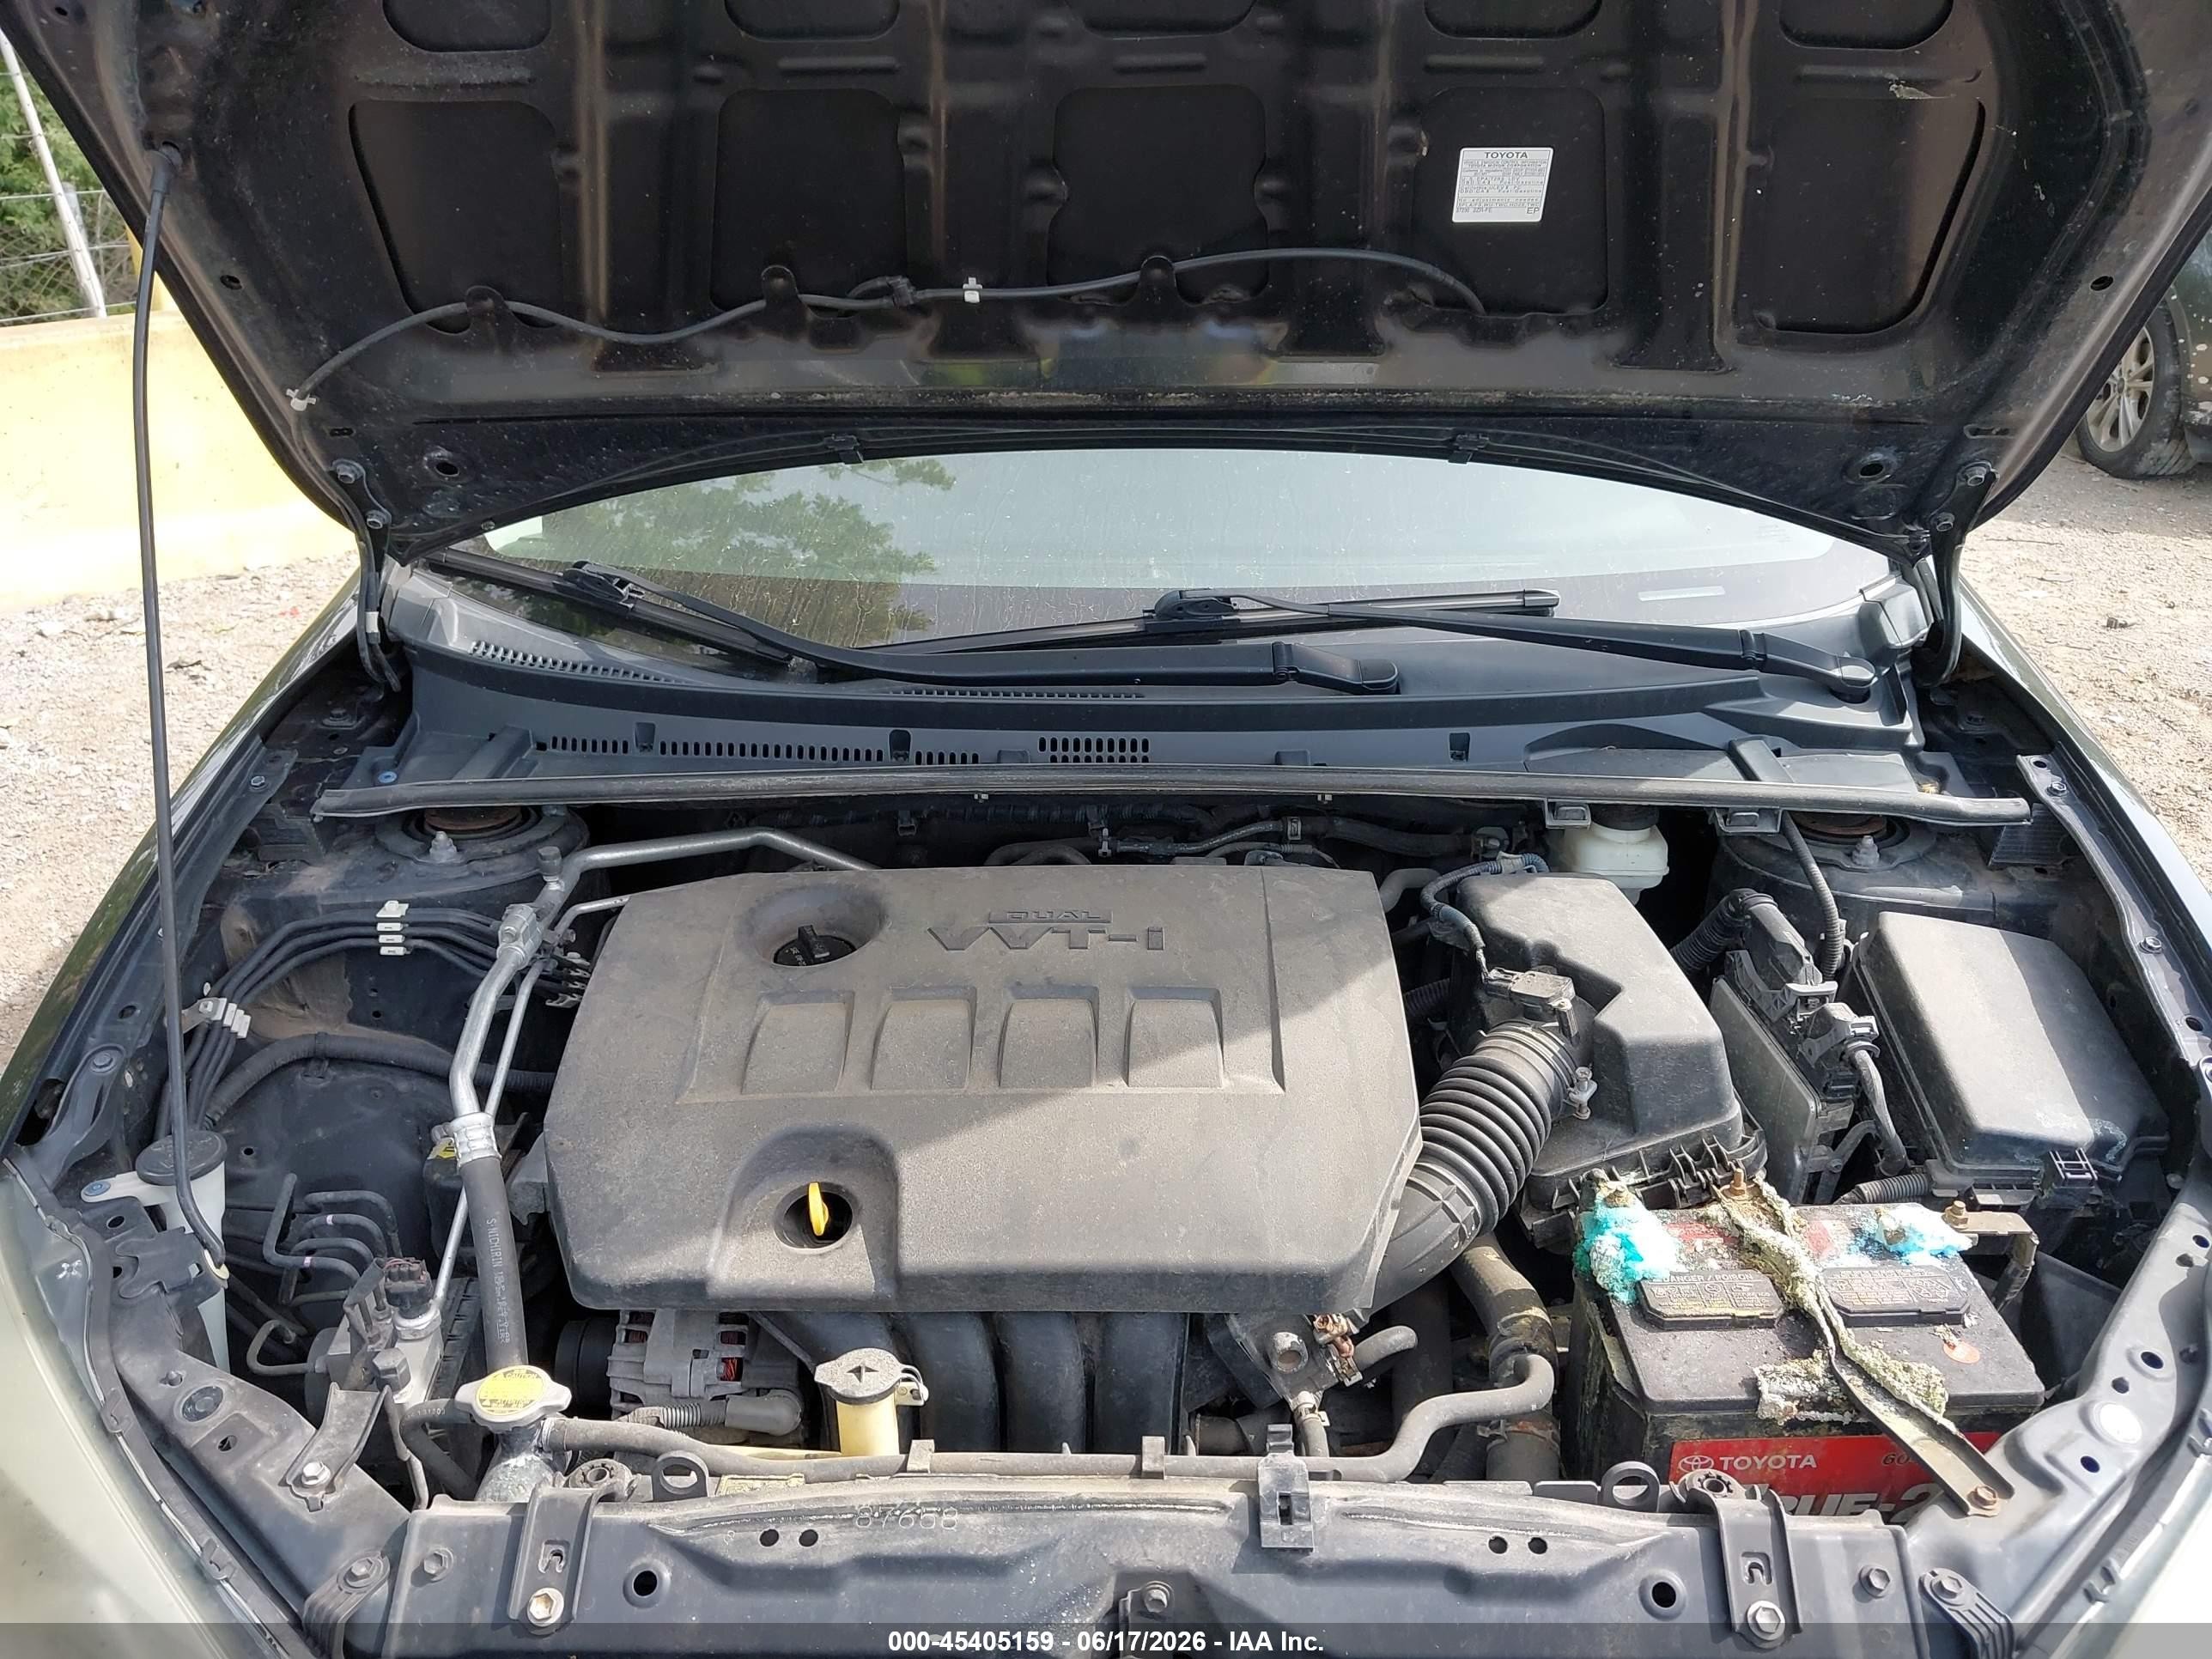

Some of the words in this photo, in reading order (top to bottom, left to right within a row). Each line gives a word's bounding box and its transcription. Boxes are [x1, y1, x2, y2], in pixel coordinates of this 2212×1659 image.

[1005, 909, 1102, 921] DUAL
[1662, 1274, 1705, 1283] DANGER
[1715, 1273, 1753, 1281] POISON
[1719, 1454, 1817, 1471] TOYOTA
